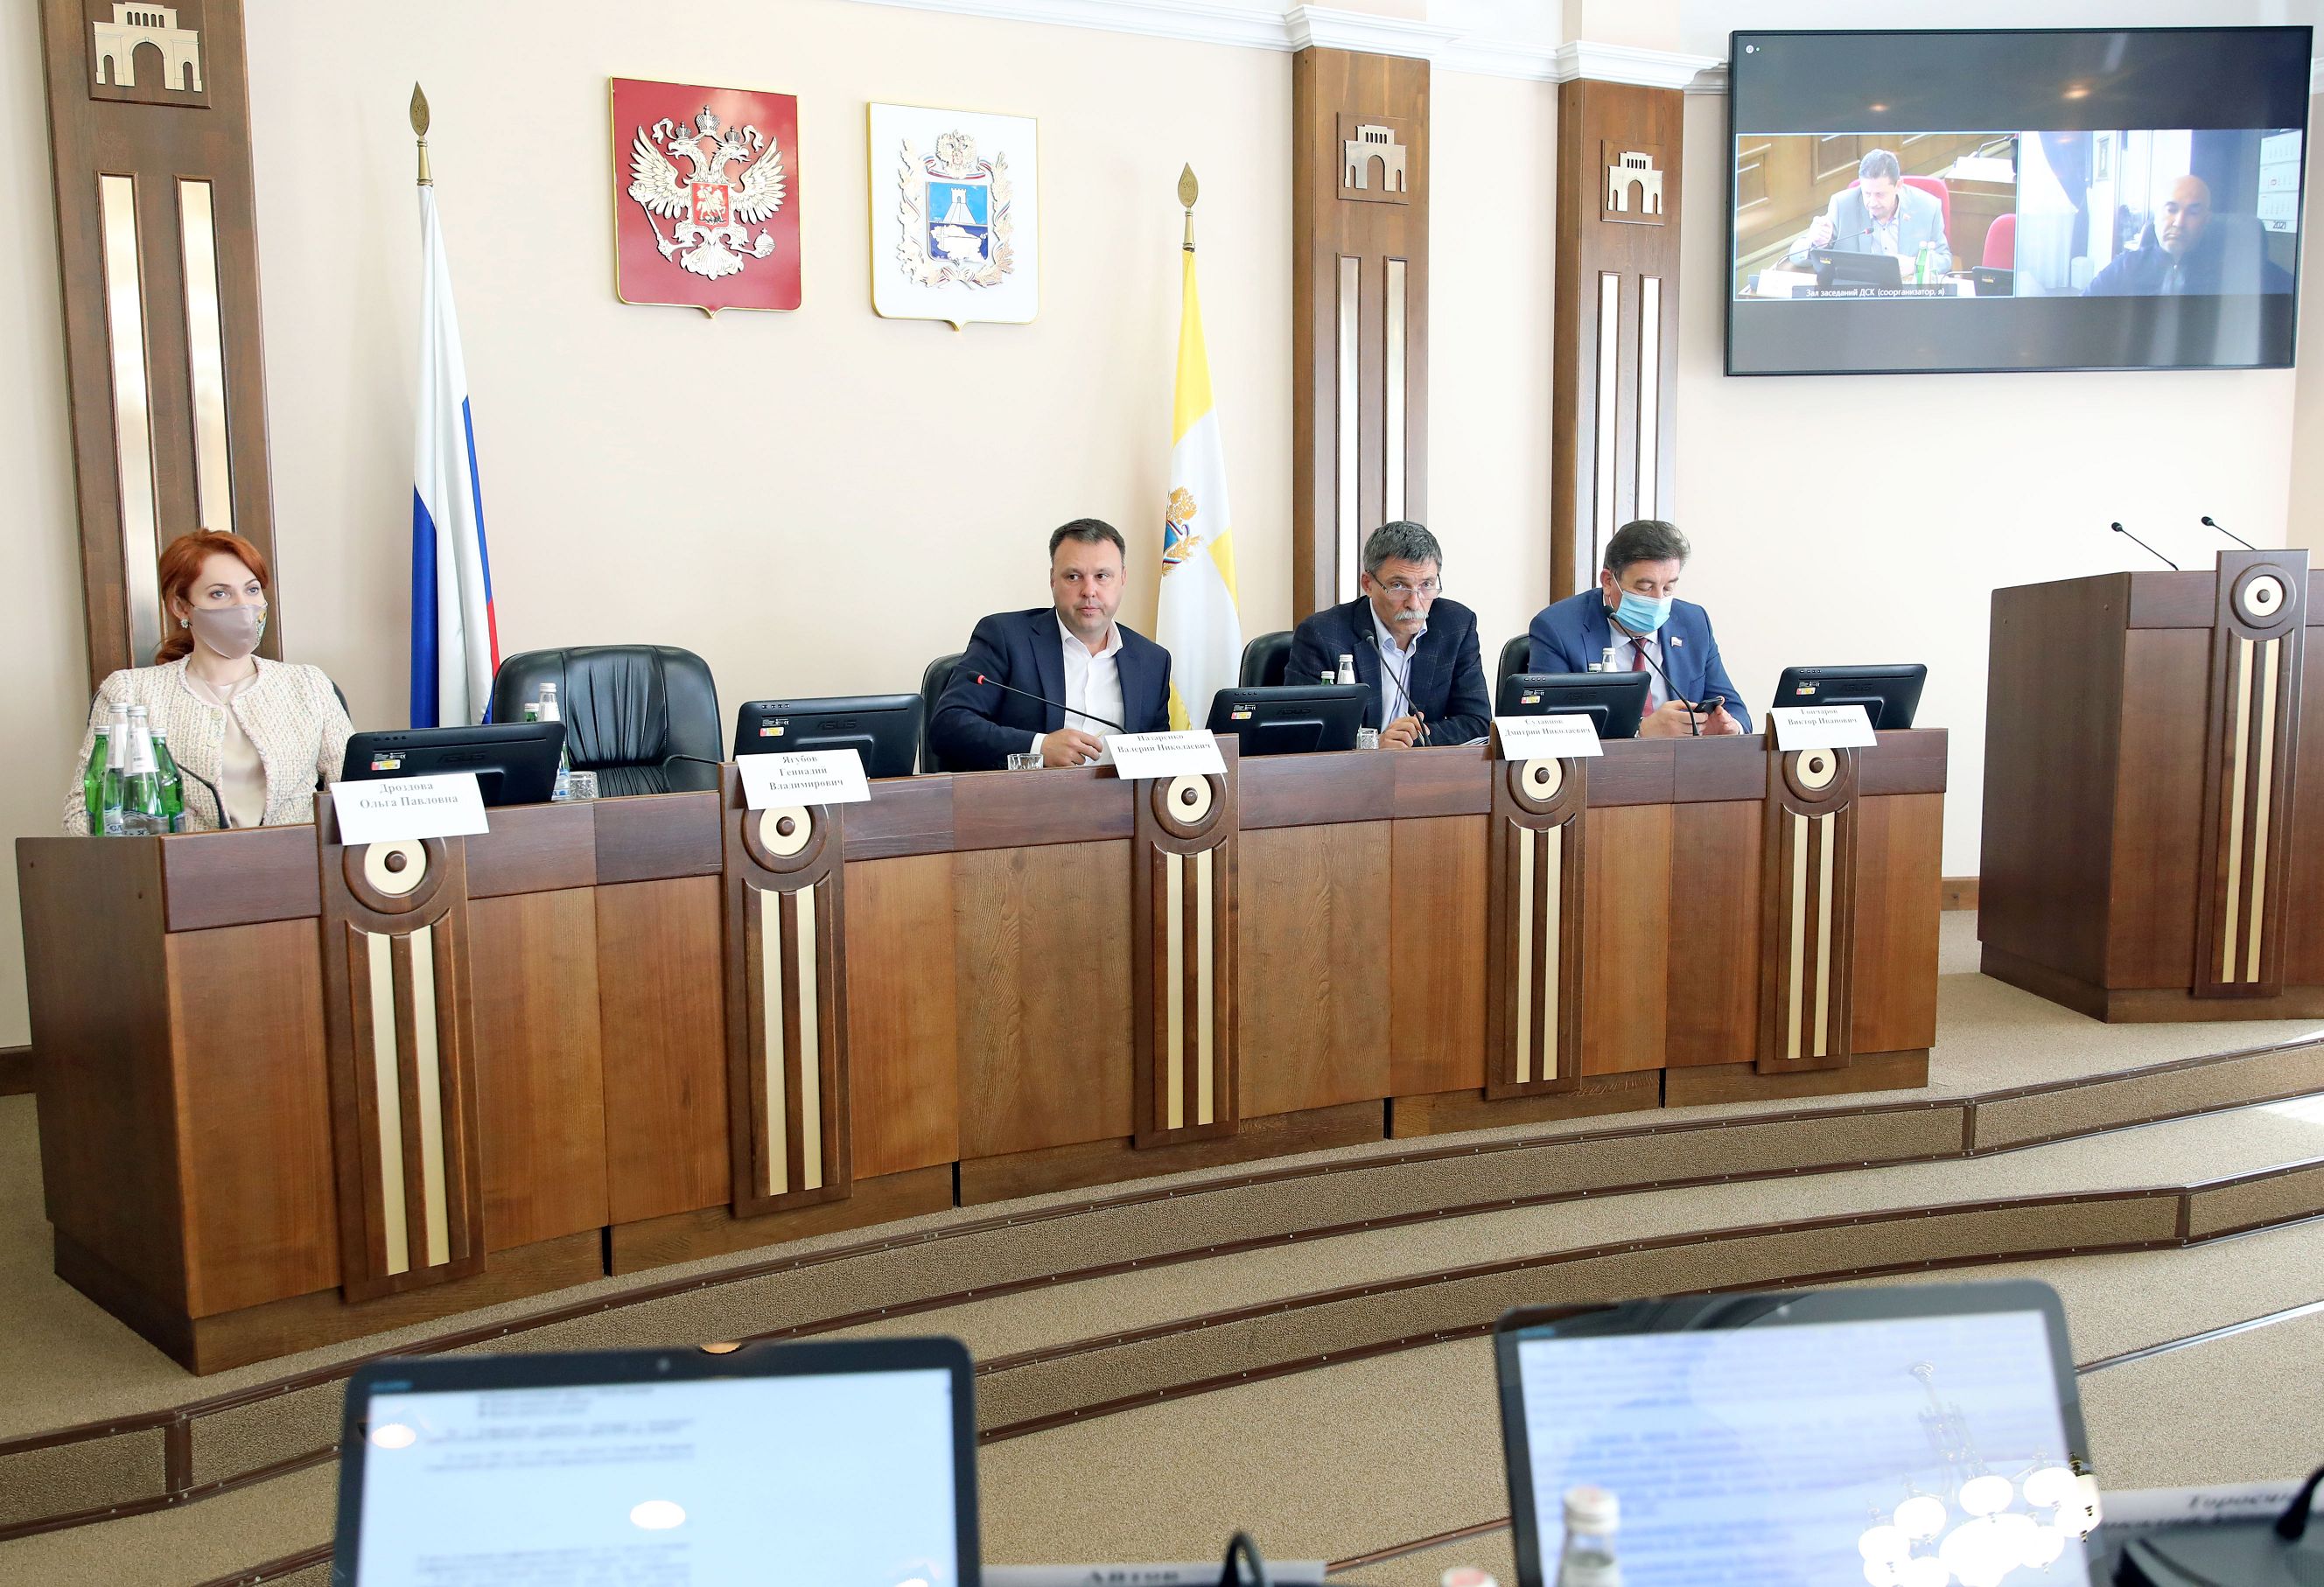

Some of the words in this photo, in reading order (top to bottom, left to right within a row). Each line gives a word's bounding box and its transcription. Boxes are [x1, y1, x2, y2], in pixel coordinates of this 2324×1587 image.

[2272, 220, 2286, 230] 2021
[1805, 289, 1819, 297] Зал
[1820, 288, 1858, 297] заседаний
[1859, 287, 1875, 297] ДСК
[1878, 287, 1936, 297] (соорганизатор,
[817, 719, 857, 730] ASUS
[1788, 717, 1816, 726] Виктор
[1116, 745, 1156, 754] Валерий
[782, 755, 818, 766] Ягубов
[779, 767, 828, 777] Геннадий
[379, 782, 434, 795] Дроздова
[769, 779, 844, 791] Владимирович
[360, 798, 397, 809] Ольга
[401, 795, 458, 807] Павловна
